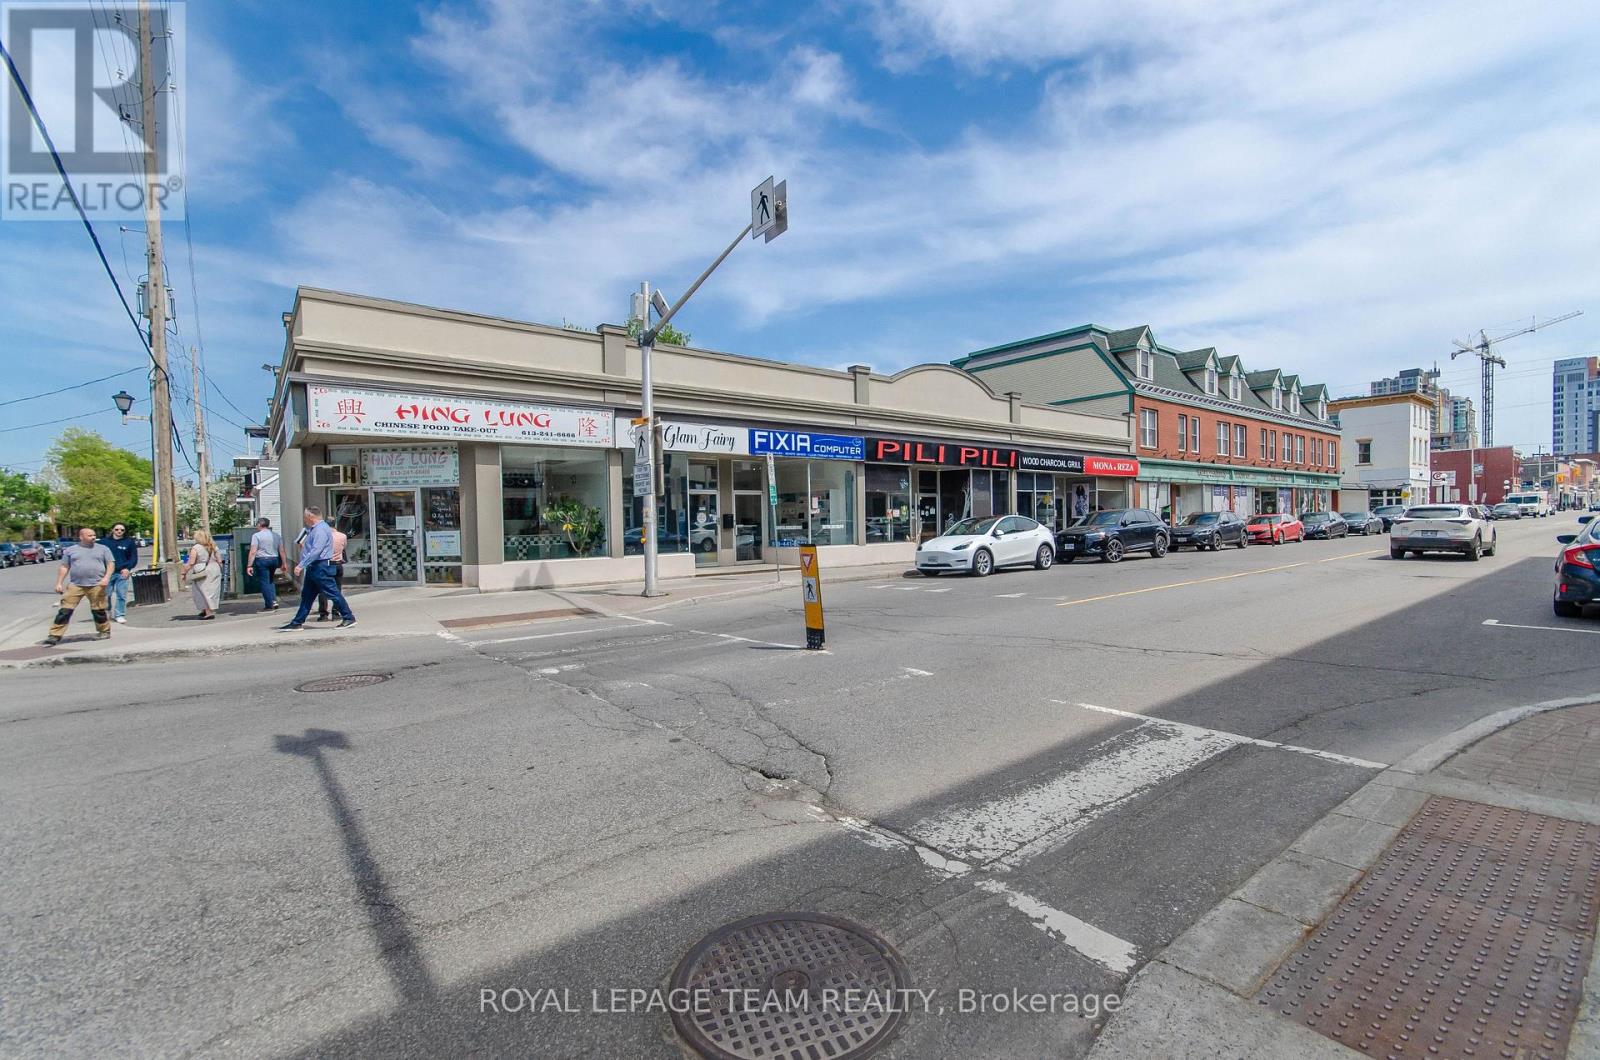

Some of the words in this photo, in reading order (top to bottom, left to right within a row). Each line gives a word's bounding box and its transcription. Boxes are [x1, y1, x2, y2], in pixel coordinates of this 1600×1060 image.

[334, 398, 366, 423] 興
[395, 403, 471, 424] HING
[484, 409, 552, 428] LUNG
[374, 421, 420, 430] CHINESE
[452, 426, 498, 434] TAKE-OUT
[521, 430, 576, 438] 613-241-6666
[577, 416, 599, 438] 隆
[664, 424, 697, 448] Glam
[698, 427, 736, 452] Fairy
[754, 431, 811, 452] FIXIA
[813, 444, 862, 455] COMPUTER
[877, 440, 945, 463] PILI
[960, 447, 1017, 468] PILI
[1022, 456, 1040, 466] WOOD
[1040, 458, 1067, 468] CHARCOAL
[1067, 461, 1082, 469] GRILL
[1092, 461, 1113, 471] MONA
[1117, 462, 1134, 472] REZA
